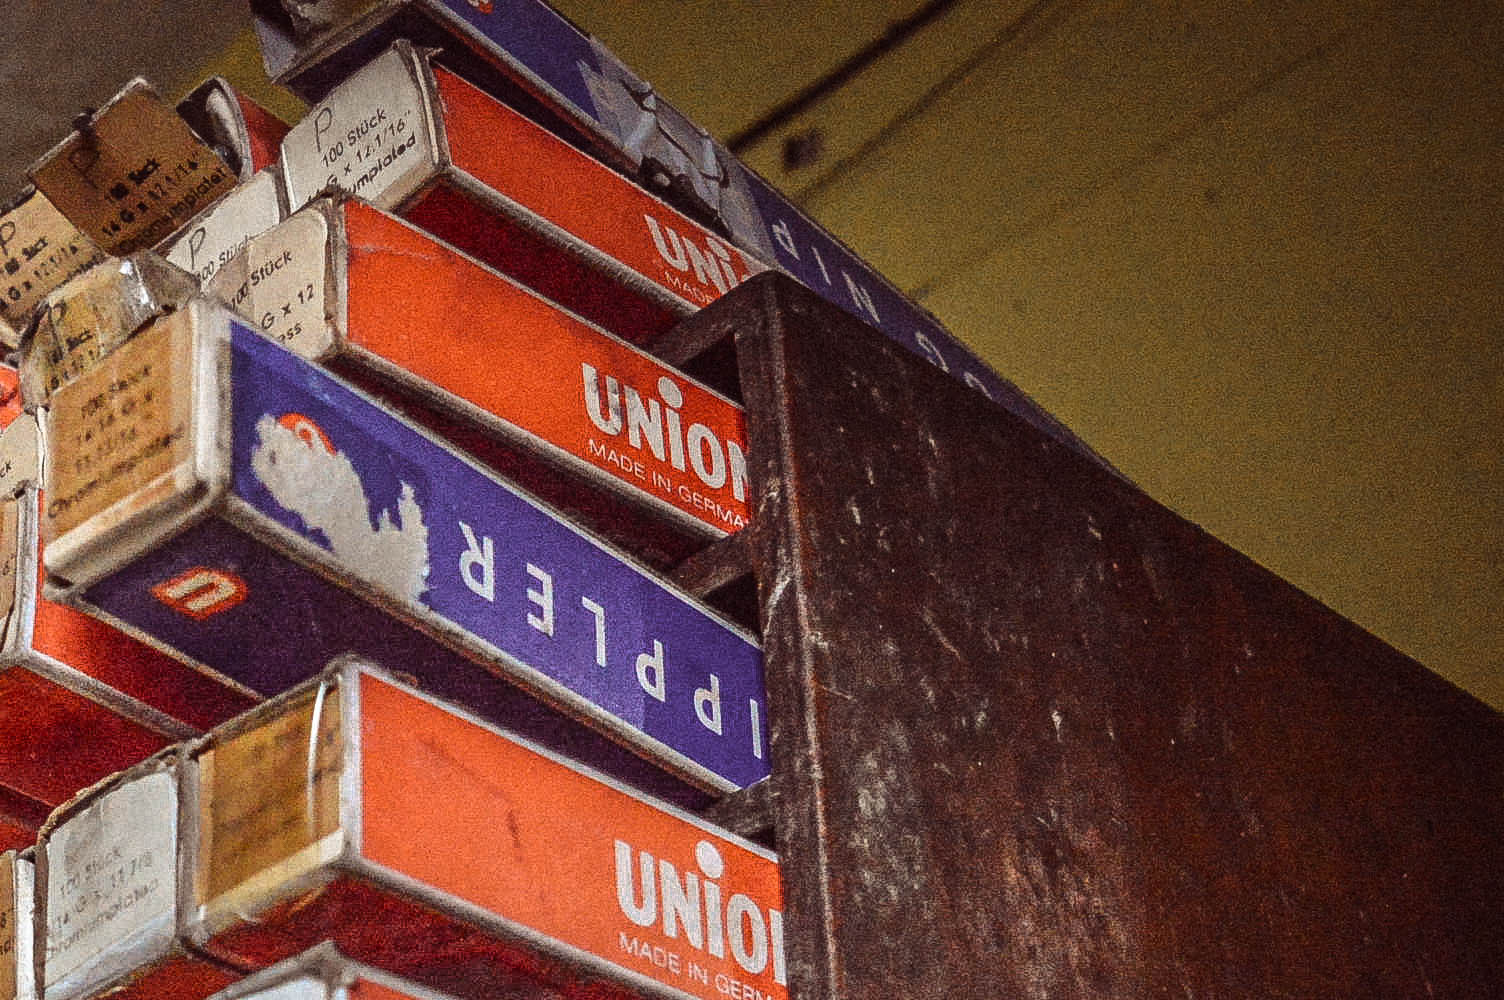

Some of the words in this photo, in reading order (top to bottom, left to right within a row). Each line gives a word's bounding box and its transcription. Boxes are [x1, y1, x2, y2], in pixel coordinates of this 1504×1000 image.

[314, 106, 333, 153] P
[322, 141, 344, 168] 100
[347, 107, 387, 147] Stück
[251, 250, 293, 288] Stück
[643, 213, 753, 296] UNi
[261, 312, 276, 331] G
[281, 302, 293, 318] x
[297, 284, 316, 306] 12
[588, 438, 647, 482] MADE
[652, 471, 673, 494] IN
[678, 484, 750, 530] GERMA
[618, 930, 682, 976] MADE
[688, 961, 710, 986] IN
